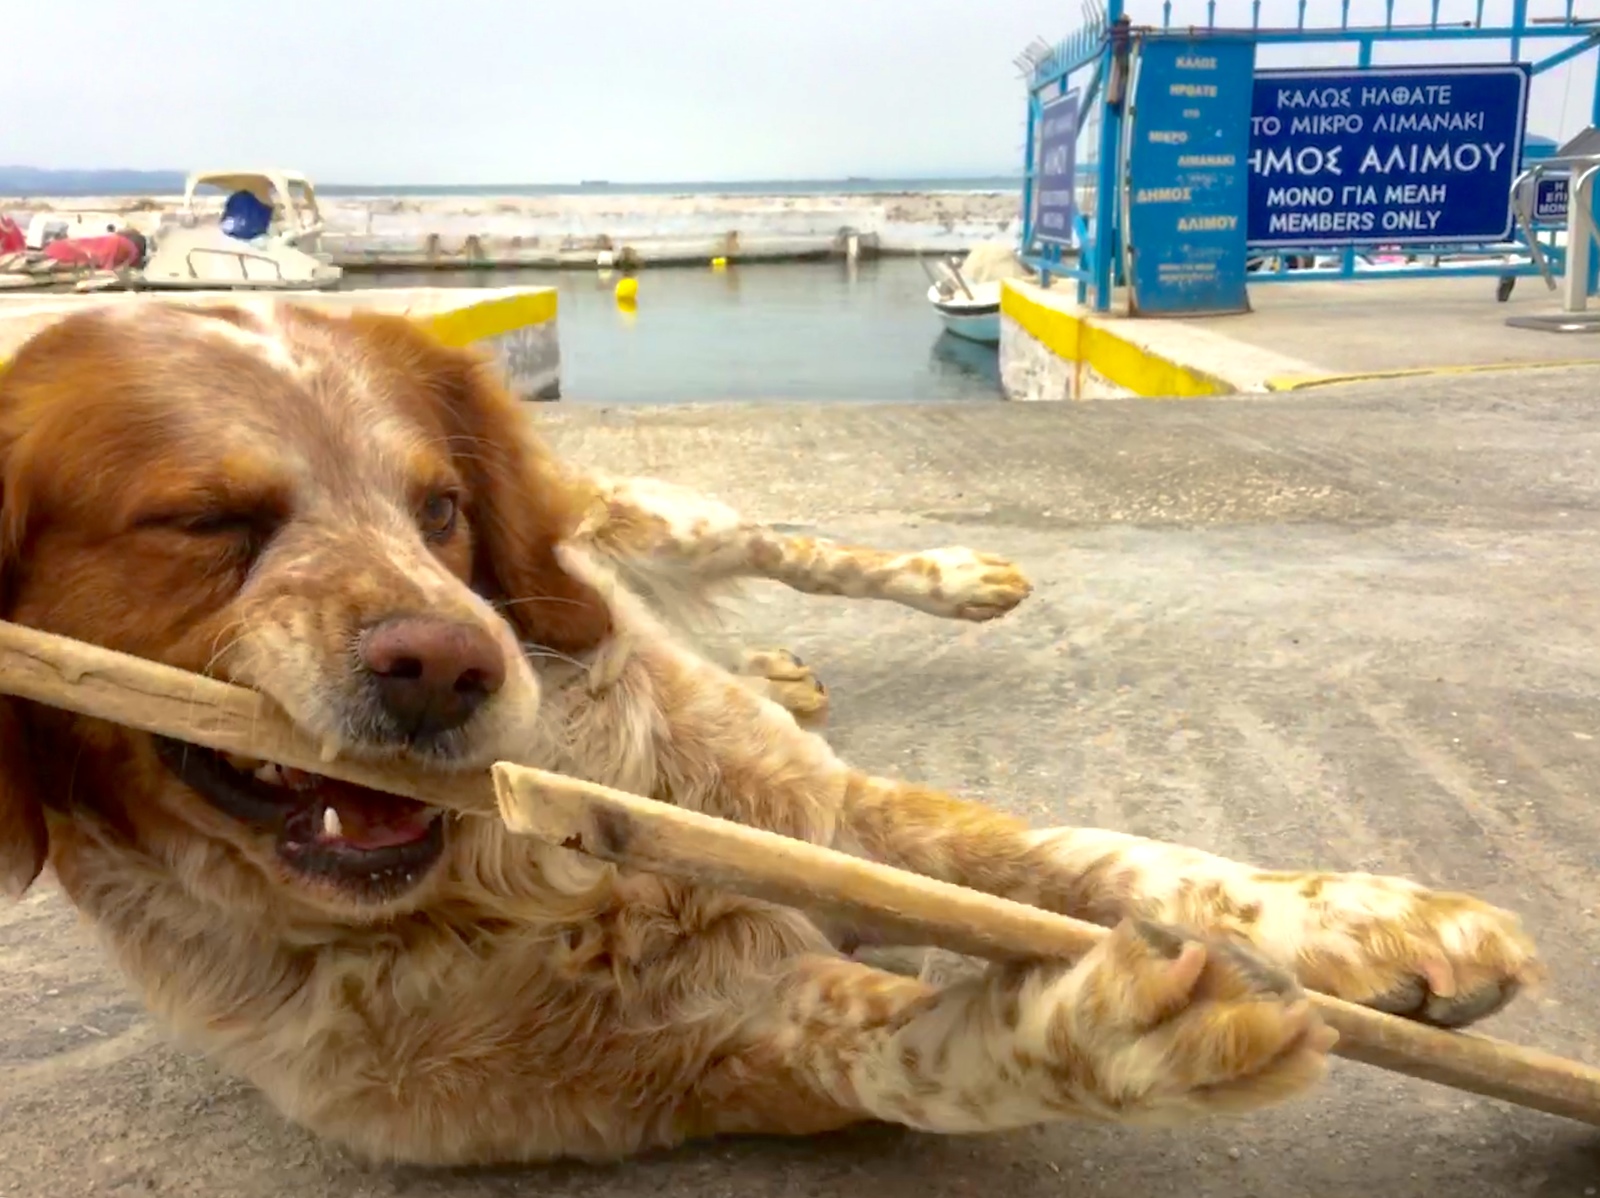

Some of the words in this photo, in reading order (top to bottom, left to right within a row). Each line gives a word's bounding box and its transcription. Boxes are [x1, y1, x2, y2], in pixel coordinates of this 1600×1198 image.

[1277, 87, 1351, 109] ΚΑΛΩΣ
[1361, 85, 1451, 106] ΗΛΘΑΤΕ
[1251, 115, 1281, 136] ΤΟ
[1290, 114, 1363, 135] ΜΙΚΡΟ
[1373, 111, 1484, 132] ΛΙΜΑΝΑΚΙ
[1148, 131, 1187, 143] ΜΙΚΡΟ
[1248, 146, 1342, 176] ΗΜΟΣ
[1359, 142, 1505, 174] ΑΛΙΜΟΥ
[1137, 187, 1191, 202] ΔΗΜΟΣ
[1267, 186, 1334, 207] ΜΟΝΟ
[1342, 184, 1377, 205] ΓΙΑ
[1384, 184, 1446, 204] ΜΕΛΗ
[1539, 203, 1567, 214] ΜΟΝ
[1178, 215, 1237, 231] ΑΛΙΜΟΥ
[1268, 211, 1375, 233] MEMBERS
[1381, 210, 1441, 230] ONLY
